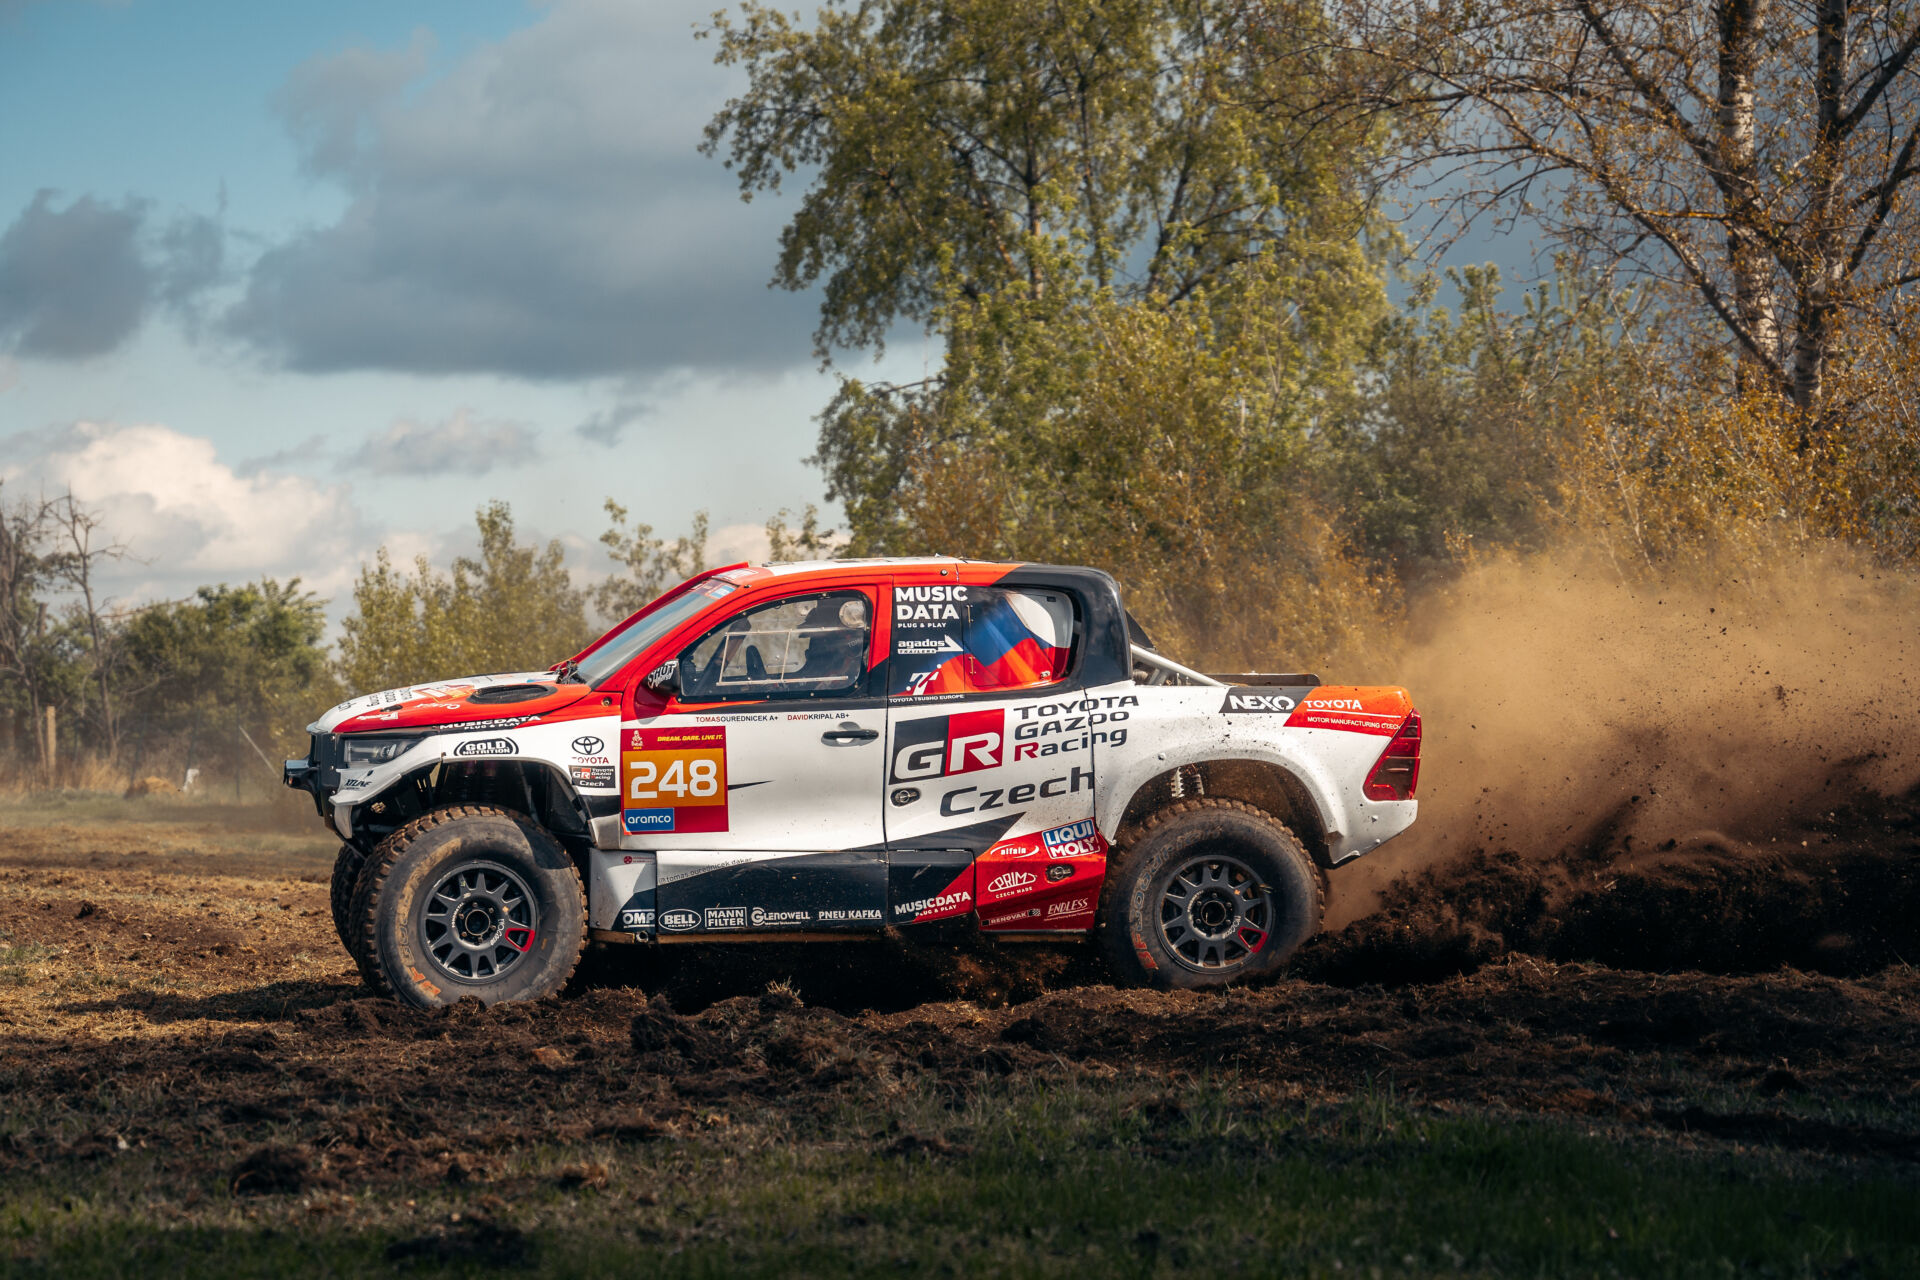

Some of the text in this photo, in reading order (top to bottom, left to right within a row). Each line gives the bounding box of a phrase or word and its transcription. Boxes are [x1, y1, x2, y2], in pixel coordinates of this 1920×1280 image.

[895, 586, 968, 602] MUSIC
[897, 604, 960, 620] DATA
[898, 639, 945, 648] agados
[1013, 695, 1139, 719] TOYOTA
[1229, 695, 1295, 712] NEXO
[1303, 699, 1362, 710] TOYOTA
[440, 715, 541, 730] MUSICDATA
[1014, 711, 1129, 740] GAZOO
[1331, 718, 1380, 729] MANUFACTURING
[465, 740, 507, 751] GOLD
[1014, 729, 1128, 762] Racing
[894, 731, 1002, 780] GR
[630, 759, 718, 799] 248
[940, 767, 1094, 818] Czech
[628, 815, 671, 824] aramco
[1045, 822, 1092, 845] LIQUI
[1050, 836, 1095, 857] MOLY
[993, 872, 1029, 889] PRIM
[996, 886, 1032, 898] CZECH MADE
[894, 891, 971, 915] MUSICDATA
[1048, 898, 1089, 914] ENDLESS
[623, 912, 655, 925] OMP
[664, 914, 695, 924] BELL
[708, 909, 744, 918] MANN
[818, 909, 882, 919] PNEU KAFKA
[915, 909, 933, 917] PLUG
[708, 917, 744, 926] FILTER
